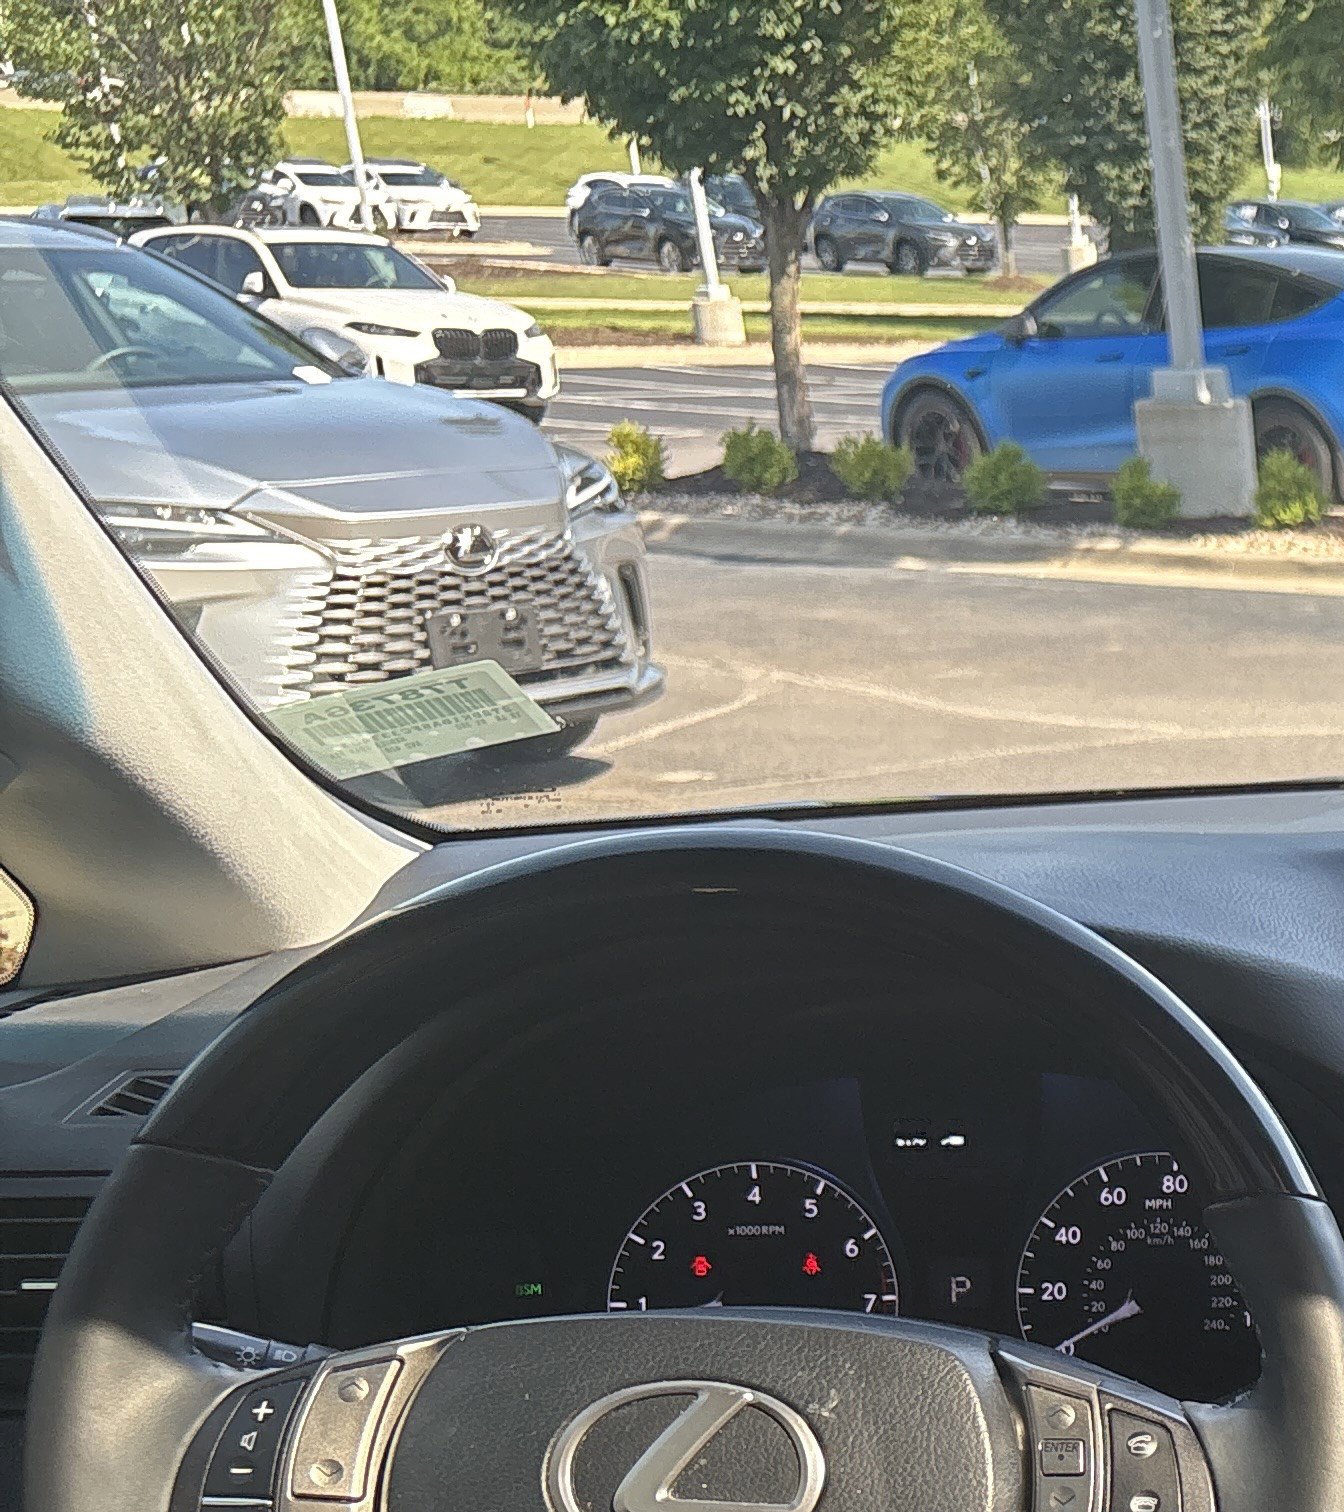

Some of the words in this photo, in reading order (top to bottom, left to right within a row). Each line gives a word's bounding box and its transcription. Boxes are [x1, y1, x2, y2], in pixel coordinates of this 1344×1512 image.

[1161, 1174, 1189, 1194] 80
[747, 1185, 761, 1205] 4
[1100, 1187, 1127, 1206] 60
[804, 1199, 818, 1219] 5
[1145, 1199, 1173, 1210] MPH
[692, 1201, 707, 1222] 3
[1126, 1228, 1146, 1240] 100
[1150, 1222, 1169, 1234] 120
[1173, 1226, 1192, 1238] 140
[1055, 1226, 1081, 1245] 40
[1147, 1236, 1175, 1246] km/h
[845, 1238, 859, 1259] 6
[1110, 1240, 1126, 1252] 80
[1189, 1238, 1209, 1250] 160
[651, 1240, 666, 1261] 2
[1096, 1258, 1112, 1270] 60
[1204, 1254, 1224, 1266] 180
[1089, 1279, 1105, 1291] 40
[1210, 1275, 1232, 1287] 200
[951, 1276, 971, 1304] P
[1041, 1282, 1067, 1301] 20
[638, 1296, 647, 1312] 1
[863, 1293, 877, 1313] 7
[1091, 1301, 1106, 1313] 20
[1211, 1296, 1232, 1308] 220
[1204, 1318, 1225, 1330] 240
[1044, 1441, 1079, 1453] ENTER
